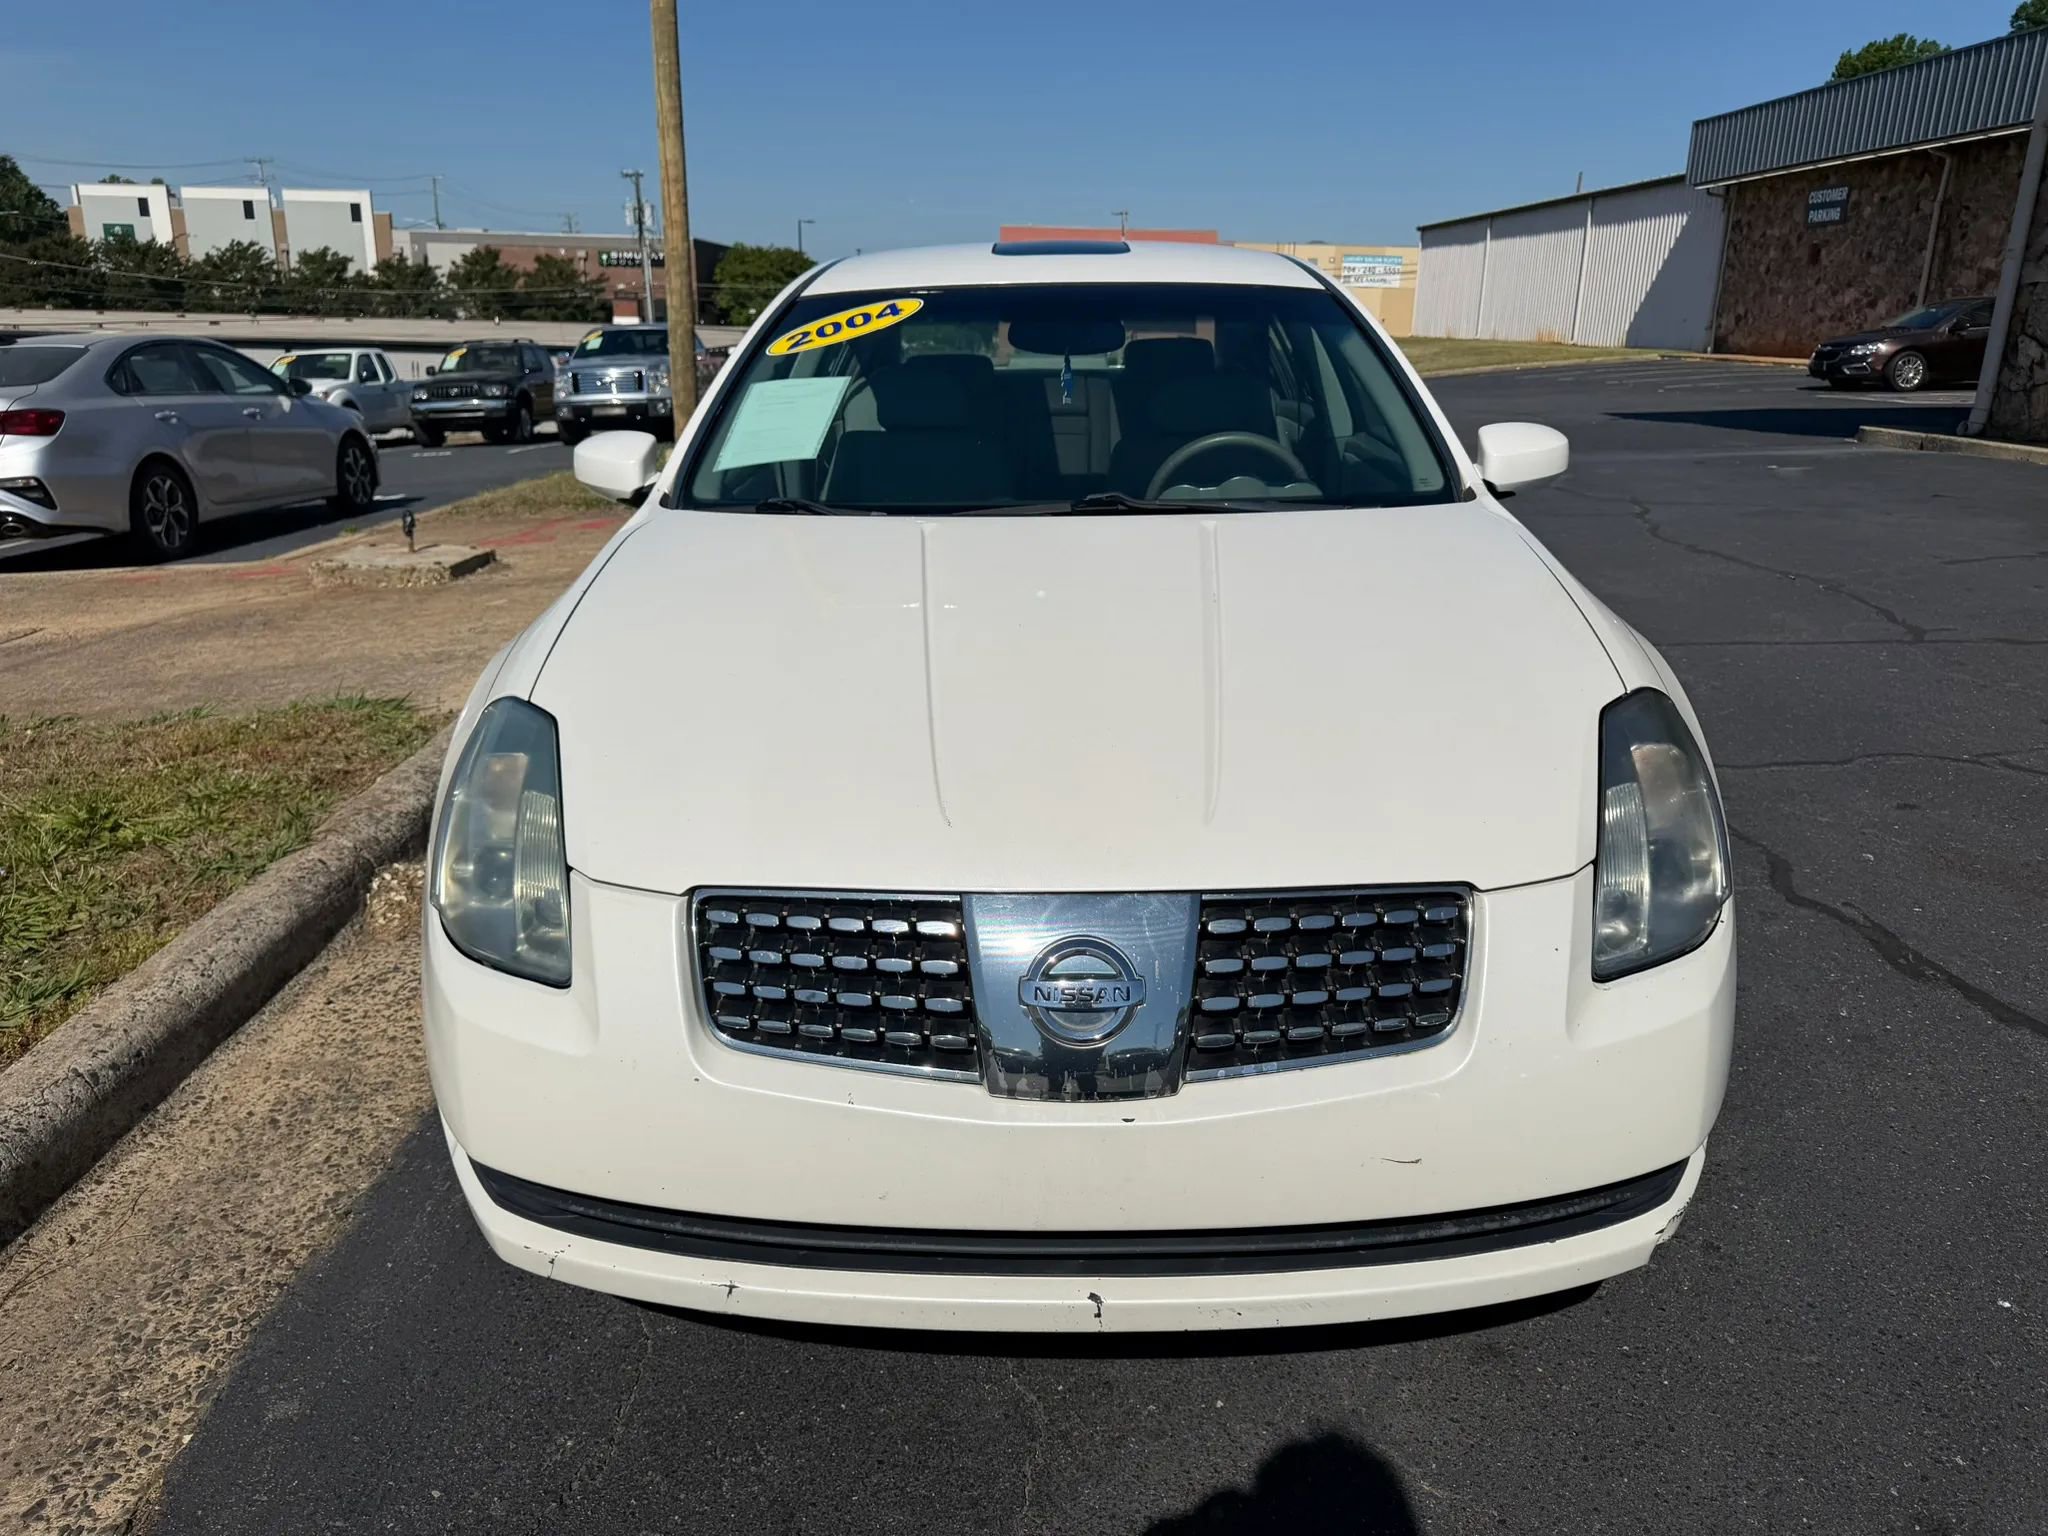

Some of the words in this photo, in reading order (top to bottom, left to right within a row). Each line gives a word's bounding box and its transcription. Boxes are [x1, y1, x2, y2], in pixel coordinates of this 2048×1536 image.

[1808, 186, 1849, 204] CUSTOMER
[1808, 207, 1841, 224] PARKING
[786, 302, 905, 351] 2004
[1034, 986, 1131, 1003] NISSAN
